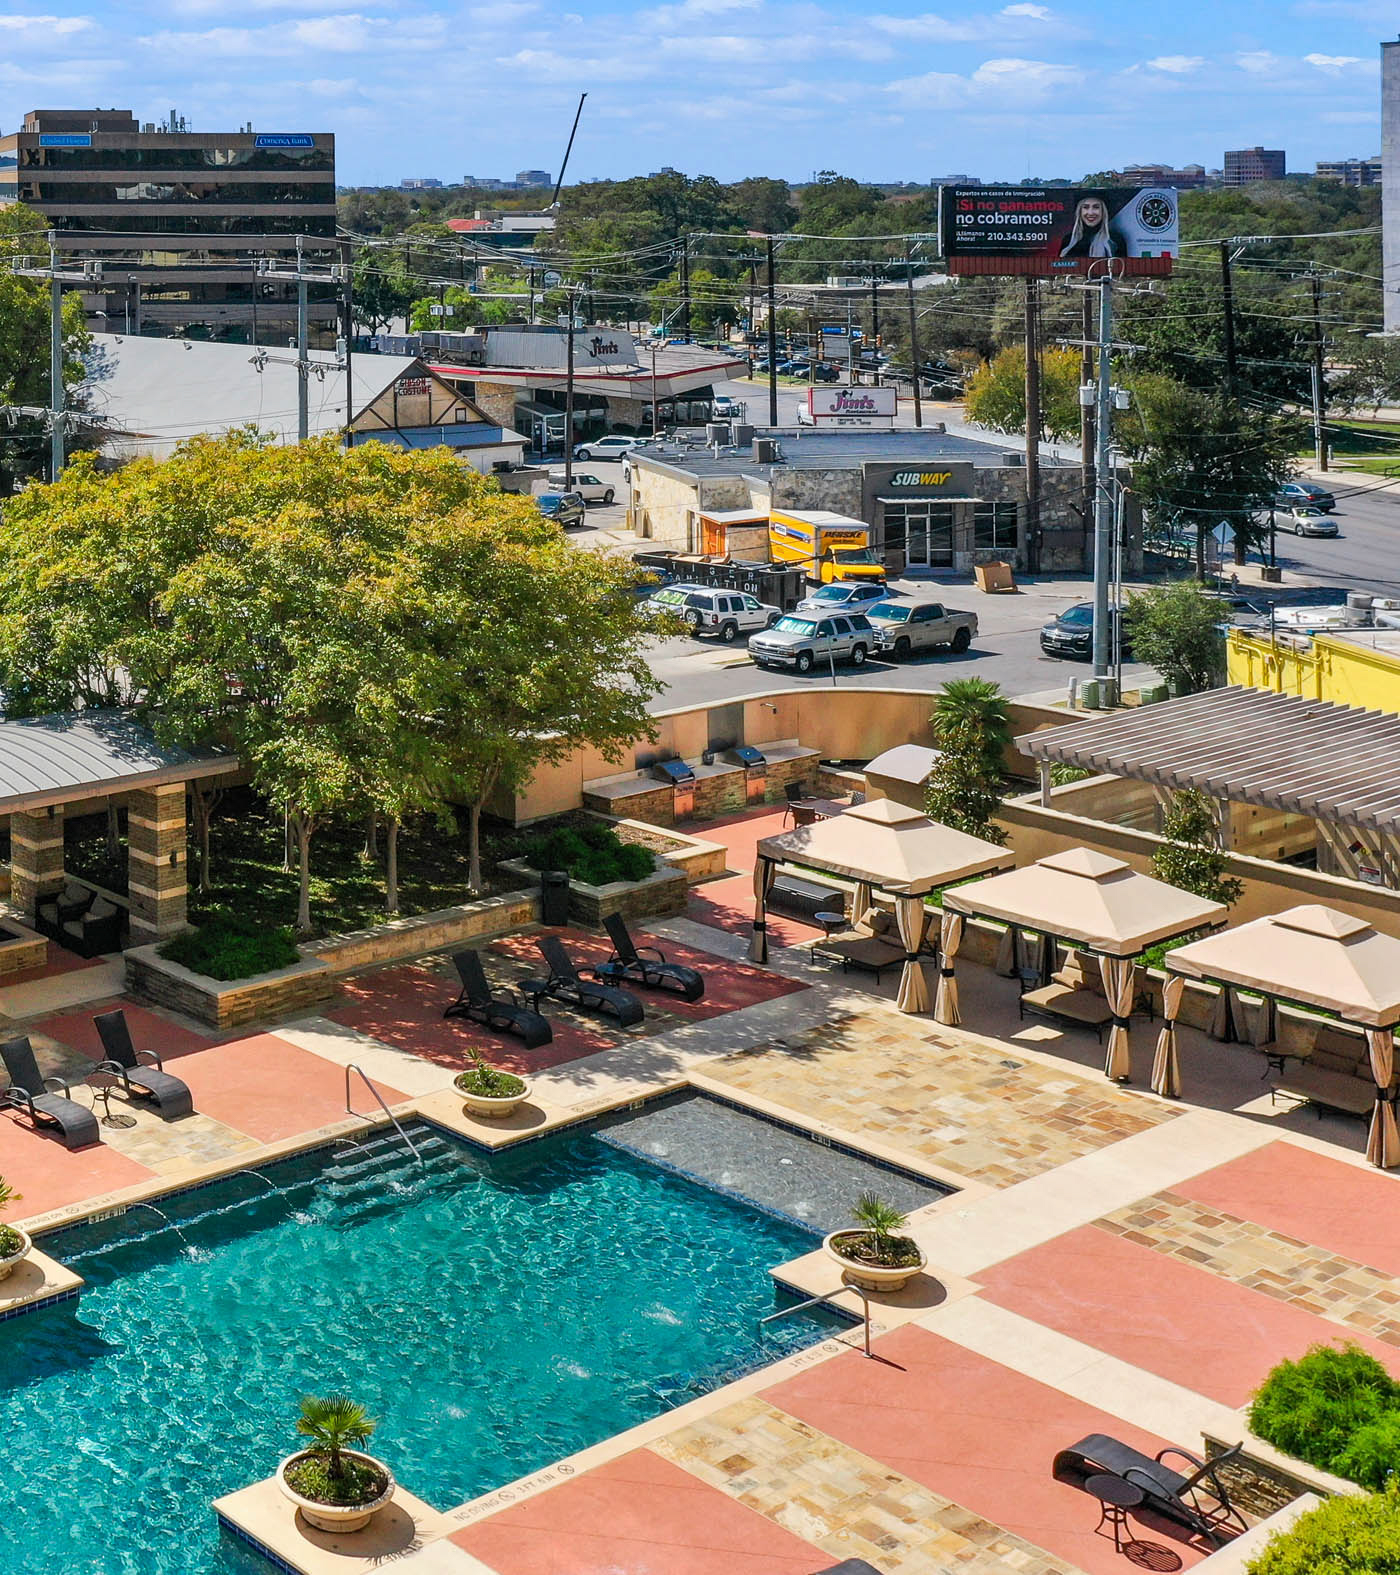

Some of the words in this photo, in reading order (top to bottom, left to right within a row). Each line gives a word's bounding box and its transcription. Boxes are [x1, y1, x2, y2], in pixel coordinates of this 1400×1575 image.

[977, 201, 995, 211] no
[999, 201, 1064, 212] ganamos
[956, 214, 975, 224] no
[977, 212, 1052, 224] cobramos!
[987, 232, 1048, 241] 210.343.5901
[590, 338, 618, 357] Jim's
[829, 391, 875, 412] Jim's
[891, 472, 952, 486] SUBWAY
